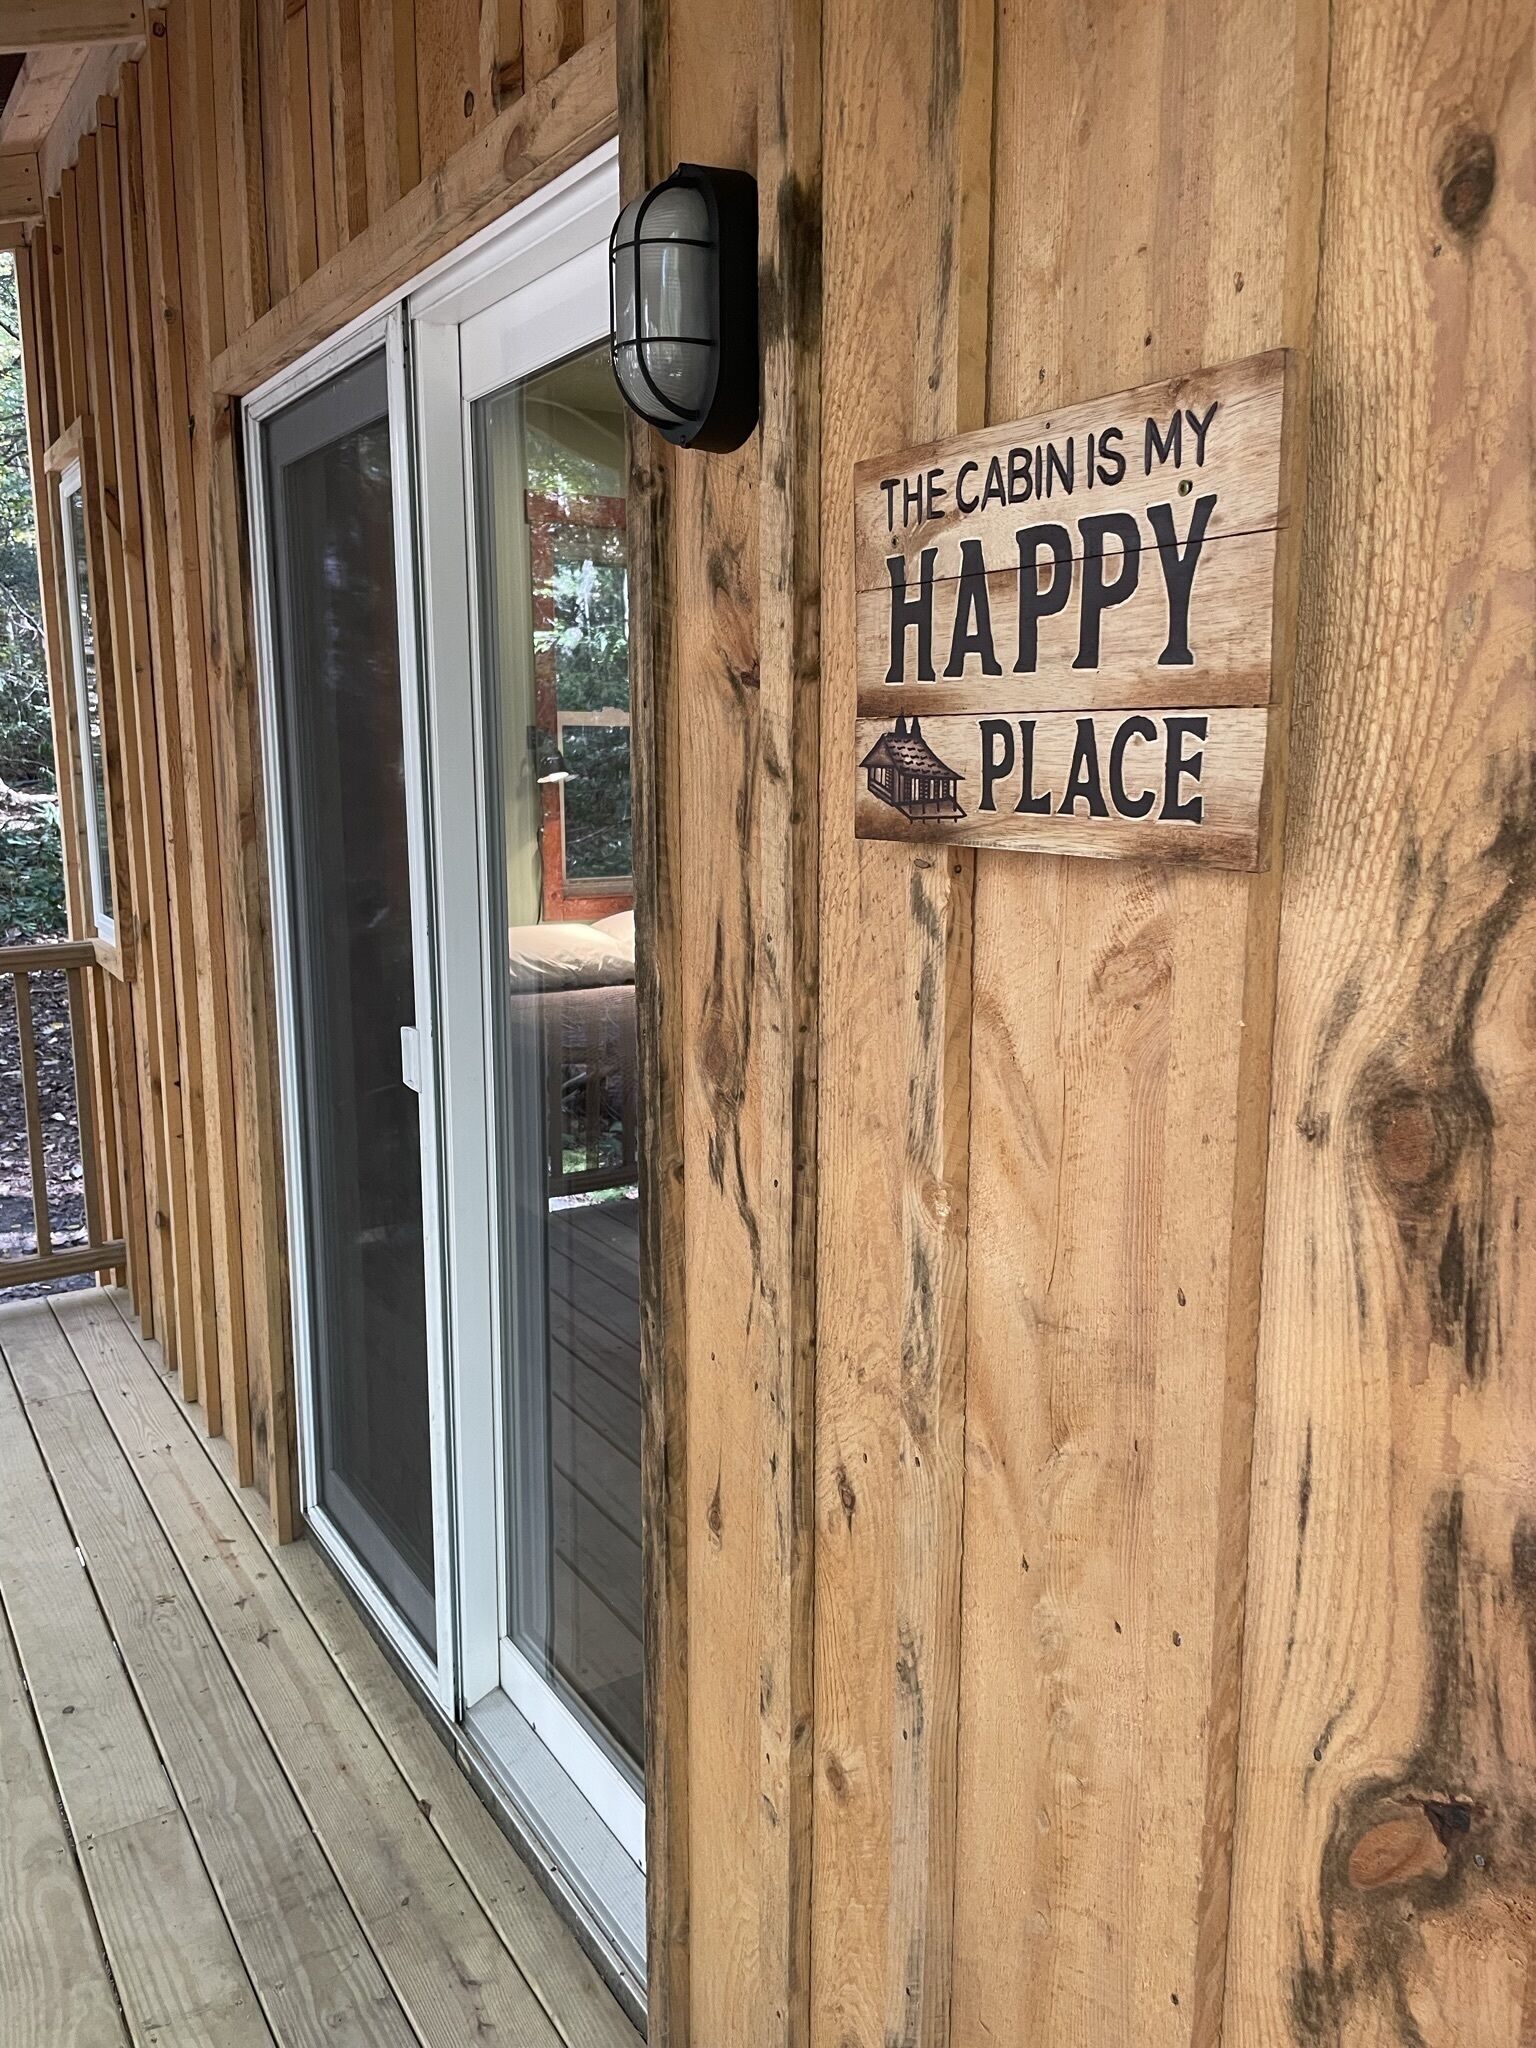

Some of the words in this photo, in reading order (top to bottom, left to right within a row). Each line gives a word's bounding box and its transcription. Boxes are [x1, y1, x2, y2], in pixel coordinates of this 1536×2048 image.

[880, 468, 947, 532] THE
[956, 436, 1074, 514] CABIN
[1087, 427, 1127, 488] IS
[1144, 401, 1219, 476] MY
[885, 494, 1218, 684] HAPPY
[978, 715, 1209, 824] PLACE
